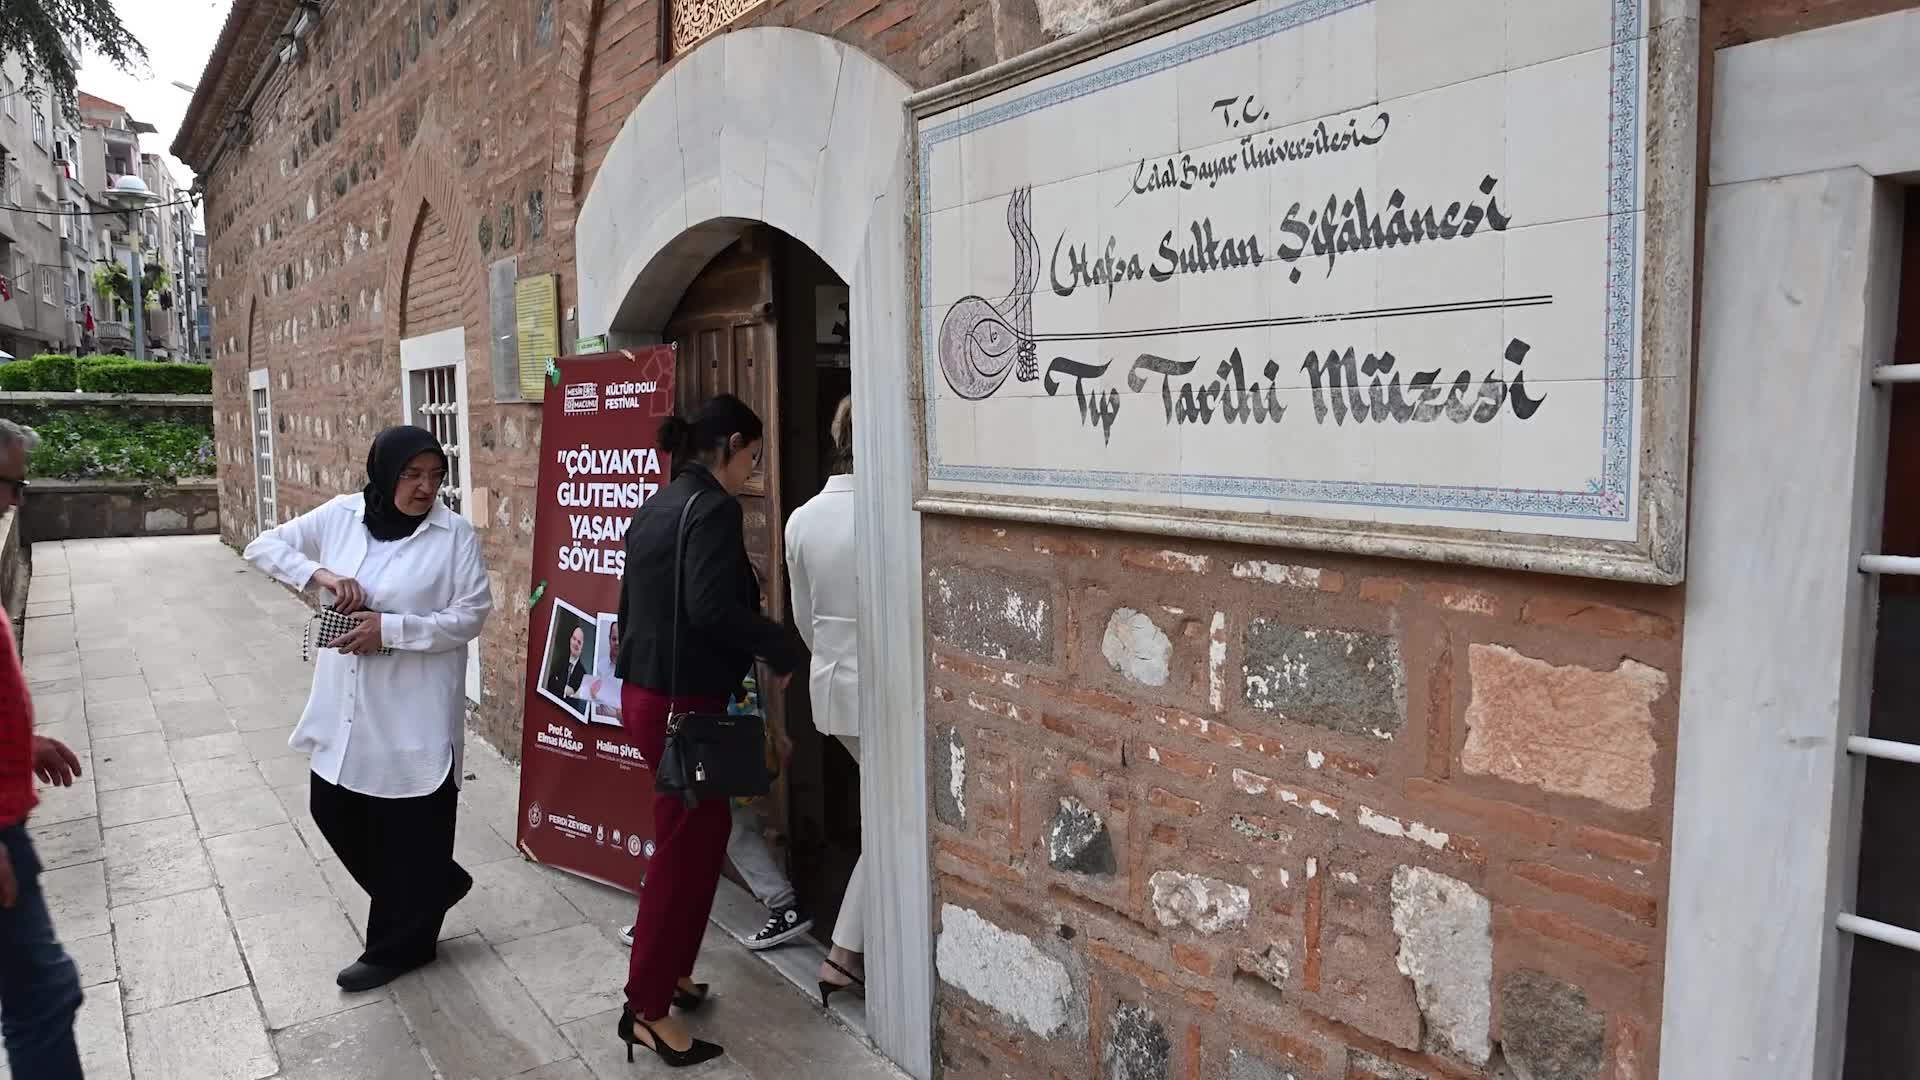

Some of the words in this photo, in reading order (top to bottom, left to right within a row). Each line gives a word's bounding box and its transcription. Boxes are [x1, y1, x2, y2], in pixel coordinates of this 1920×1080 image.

[1179, 154, 1238, 190] Bayar
[1242, 112, 1390, 171] Üniversitesi
[1149, 217, 1264, 283] Sultan
[605, 382, 635, 396] KÜLTÜR
[635, 381, 657, 394] DOLU
[1300, 337, 1547, 426] Müzesi
[605, 396, 639, 409] FESTİVAL
[558, 542, 627, 580] SÖYLEŞ
[596, 739, 619, 755] Halim
